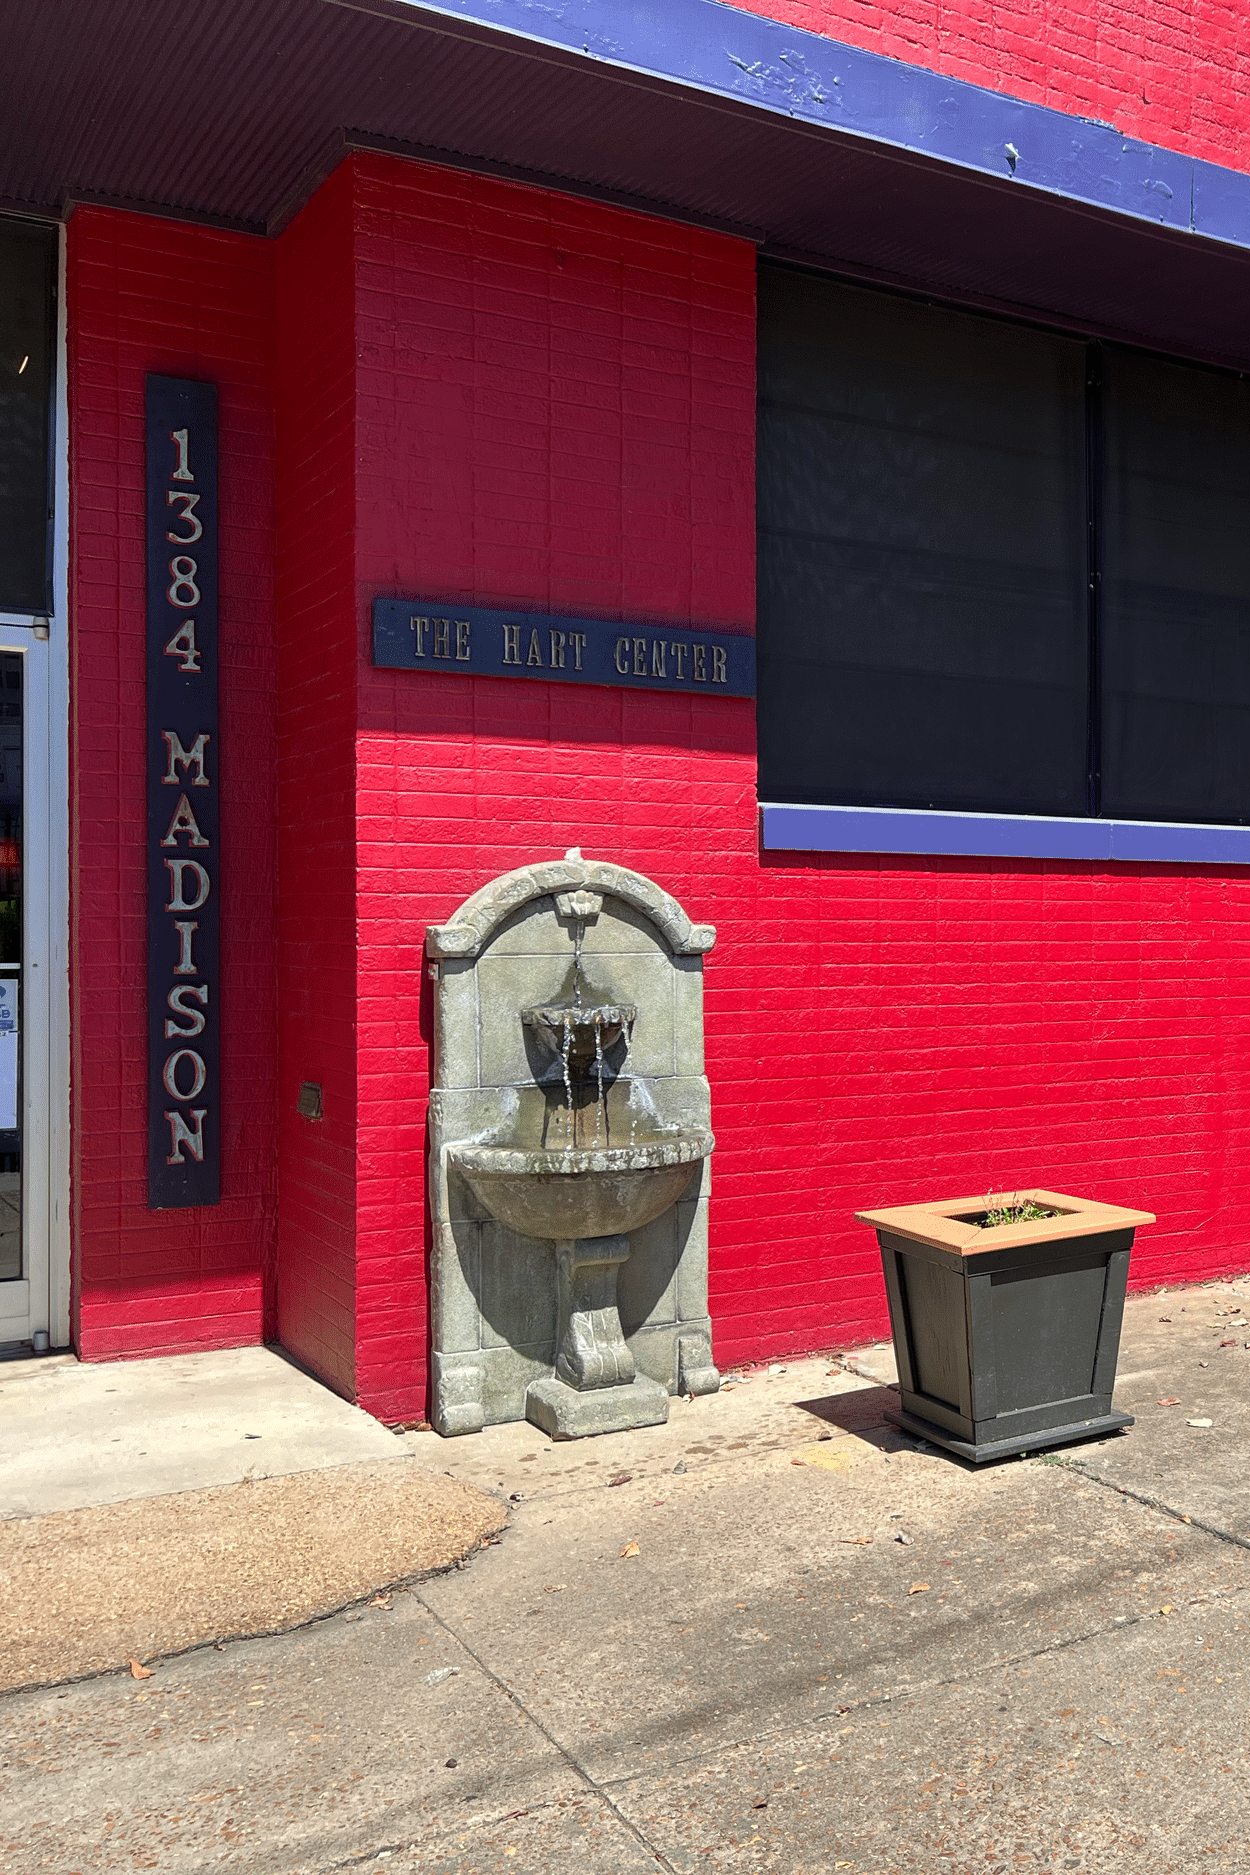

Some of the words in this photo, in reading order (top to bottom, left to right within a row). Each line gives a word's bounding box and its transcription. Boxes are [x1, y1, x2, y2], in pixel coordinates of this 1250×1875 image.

[163, 428, 203, 674] 1384
[410, 614, 471, 662] THE
[502, 623, 587, 671] HART
[614, 636, 728, 684] CENTER
[160, 730, 211, 1166] MADISON
